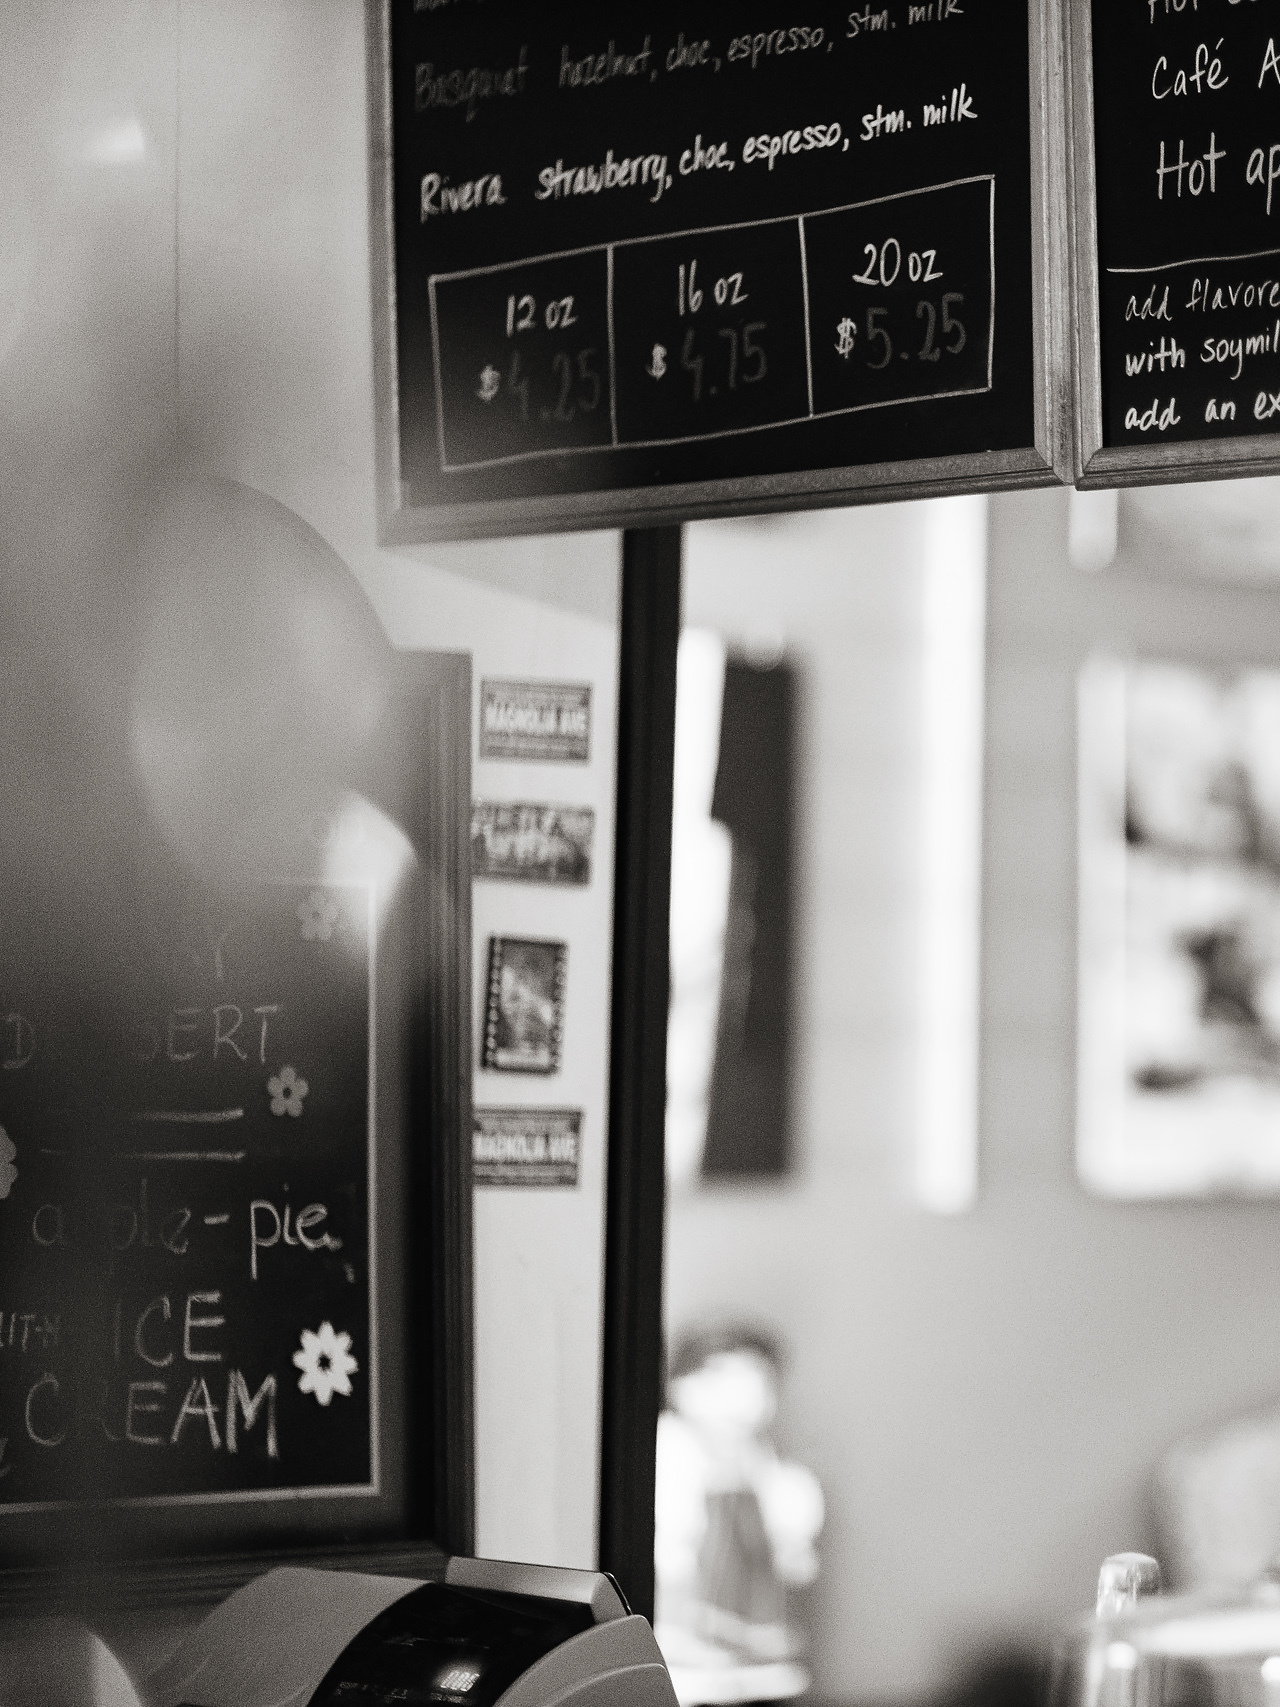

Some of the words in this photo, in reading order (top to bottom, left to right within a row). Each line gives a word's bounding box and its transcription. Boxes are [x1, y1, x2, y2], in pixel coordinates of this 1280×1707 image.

[728, 27, 834, 68] espresso,
[908, 0, 965, 25] milk
[1151, 38, 1230, 100] Café
[420, 172, 508, 224] Rivera
[534, 149, 673, 203] strawberry,
[742, 119, 850, 170] espresso,
[860, 104, 912, 142] stm.
[923, 82, 978, 127] milk
[1156, 132, 1227, 200] Hot
[677, 260, 703, 317] 16
[853, 238, 901, 287] 20
[907, 249, 943, 282] oz
[505, 295, 536, 336] 12
[1125, 285, 1173, 322] add
[1125, 335, 1187, 377] with
[1125, 397, 1181, 432] add
[1204, 398, 1236, 423] an
